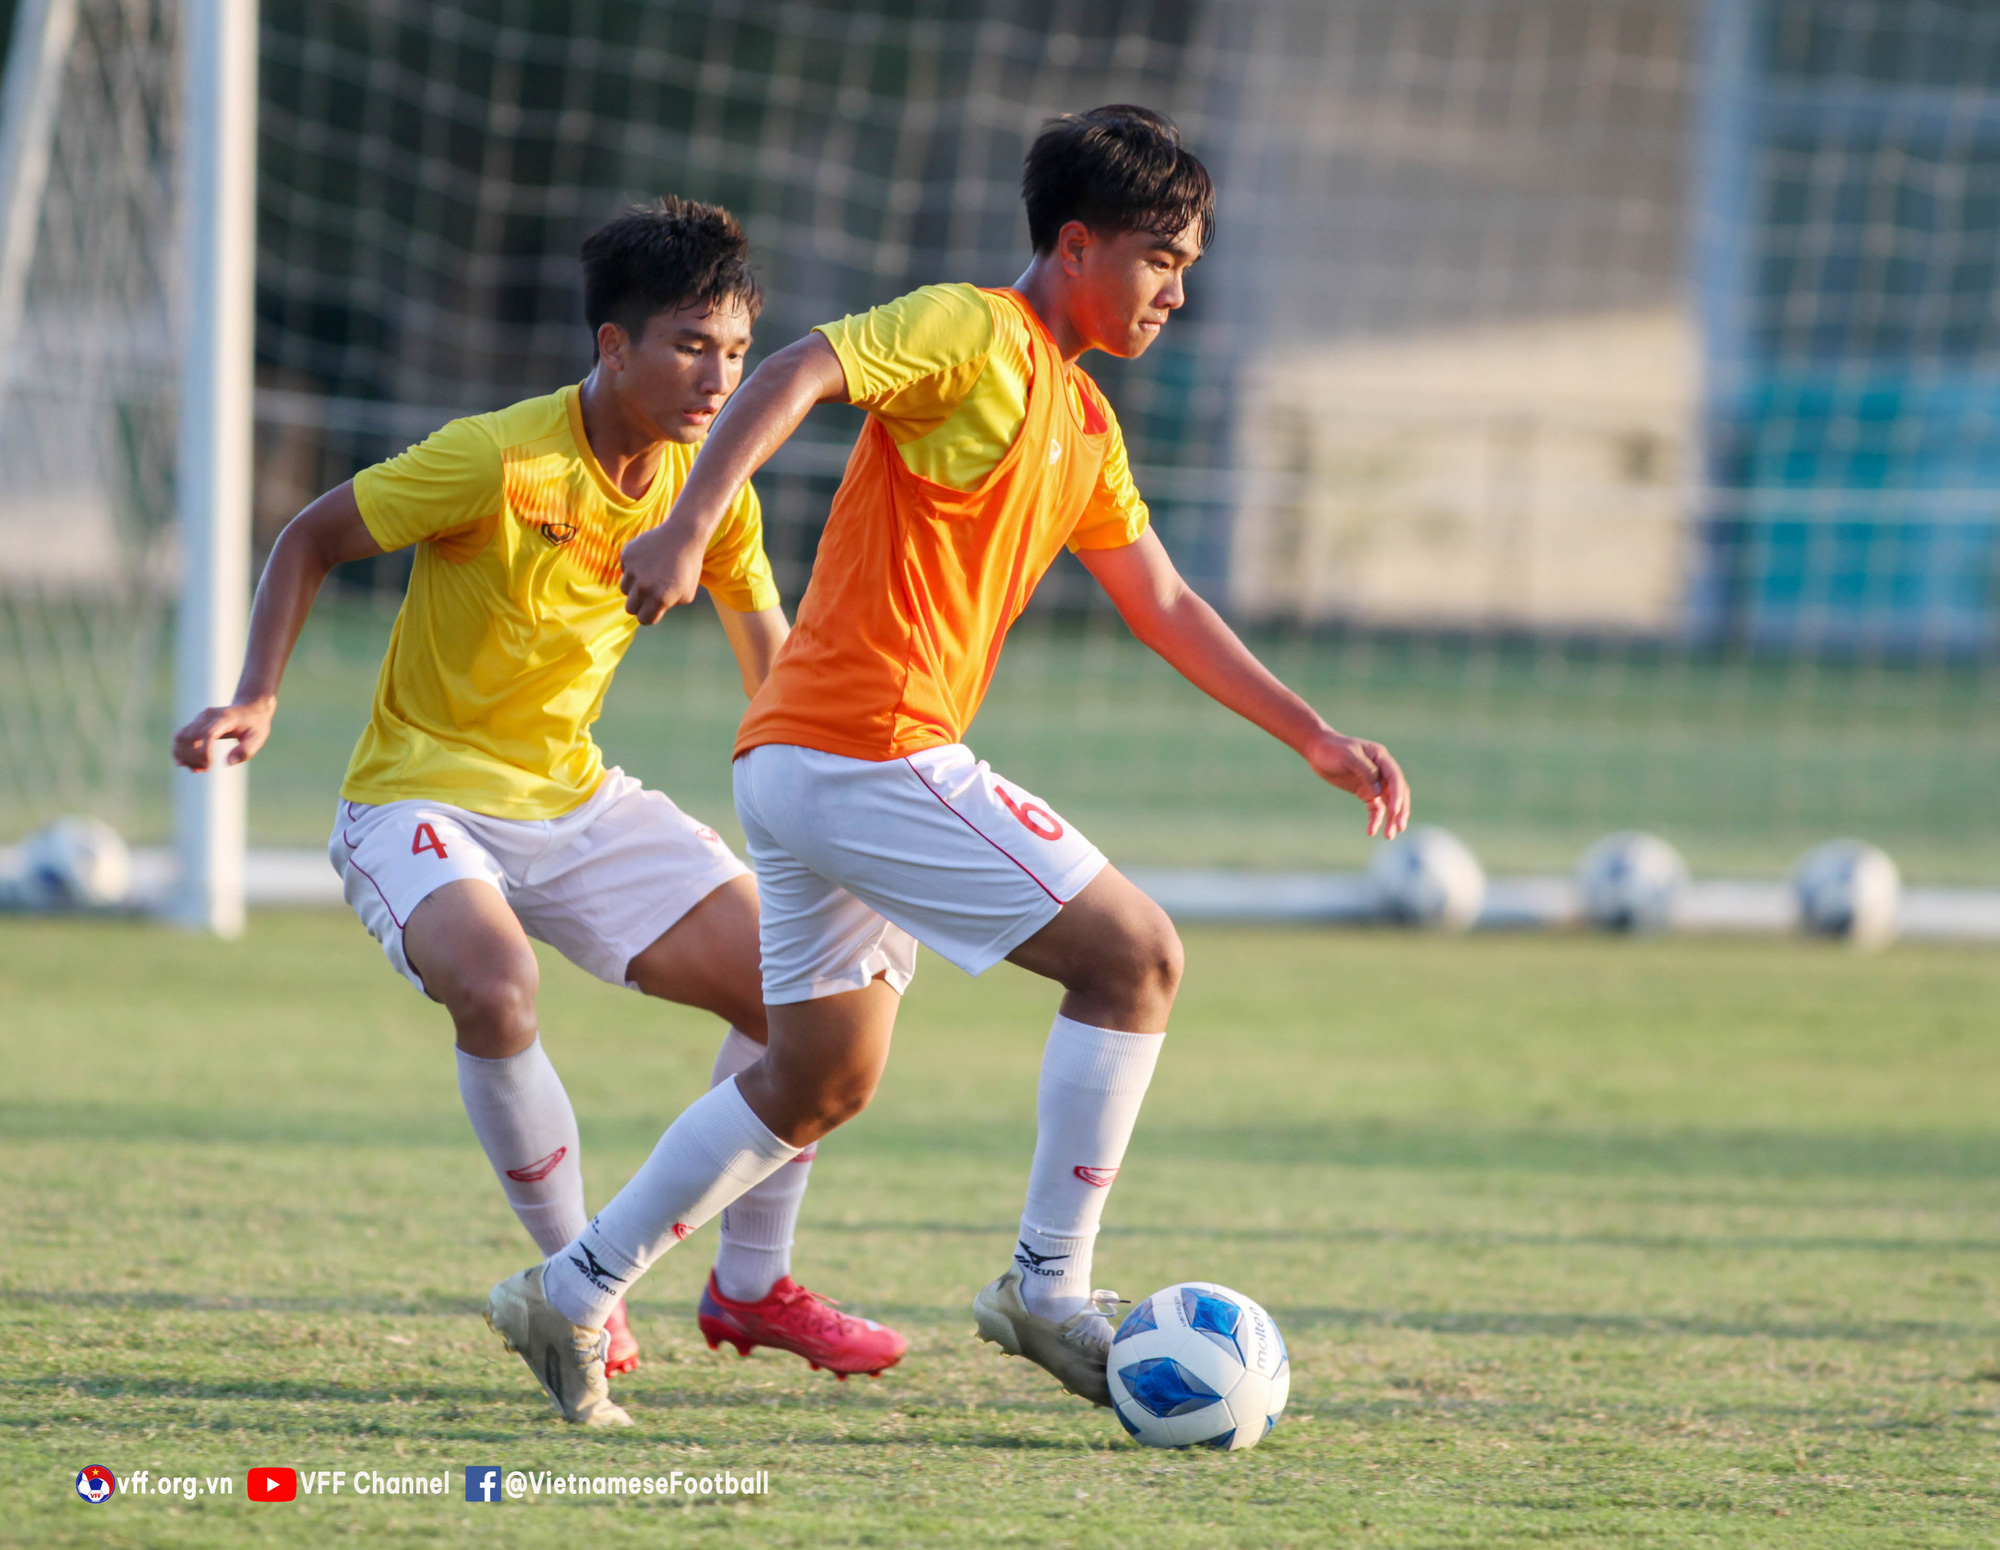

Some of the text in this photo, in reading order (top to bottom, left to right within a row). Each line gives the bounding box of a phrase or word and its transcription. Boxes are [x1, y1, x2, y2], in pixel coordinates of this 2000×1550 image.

[412, 822, 449, 860] 4
[994, 785, 1064, 841] 6
[1249, 1306, 1269, 1371] molten
